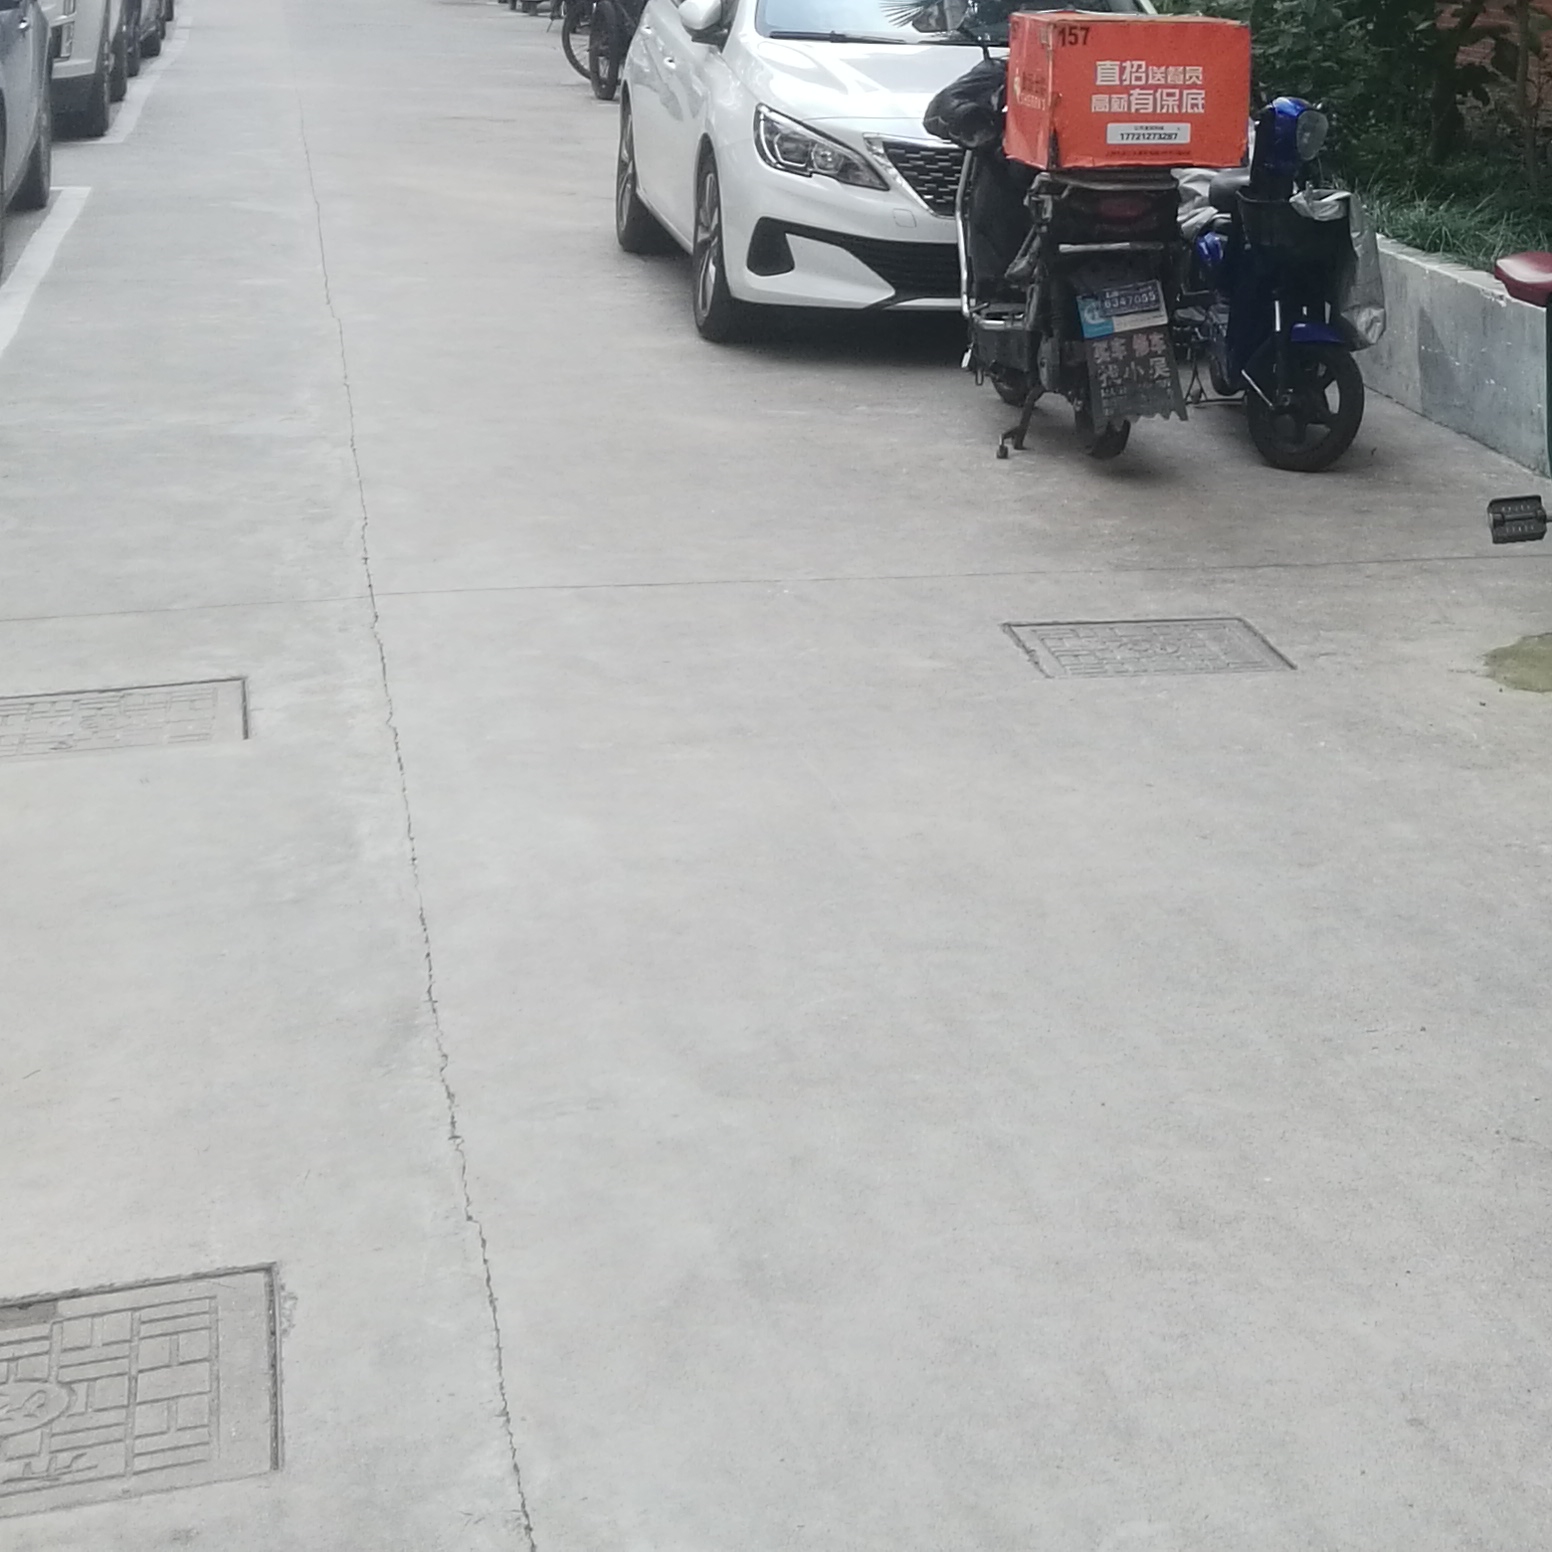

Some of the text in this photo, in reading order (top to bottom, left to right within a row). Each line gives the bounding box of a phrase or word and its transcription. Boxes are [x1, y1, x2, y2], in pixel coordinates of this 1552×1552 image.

[1058, 25, 1090, 46] 157
[1095, 60, 1203, 86] 直招送餐员
[1091, 88, 1206, 114] 高薪有保底
